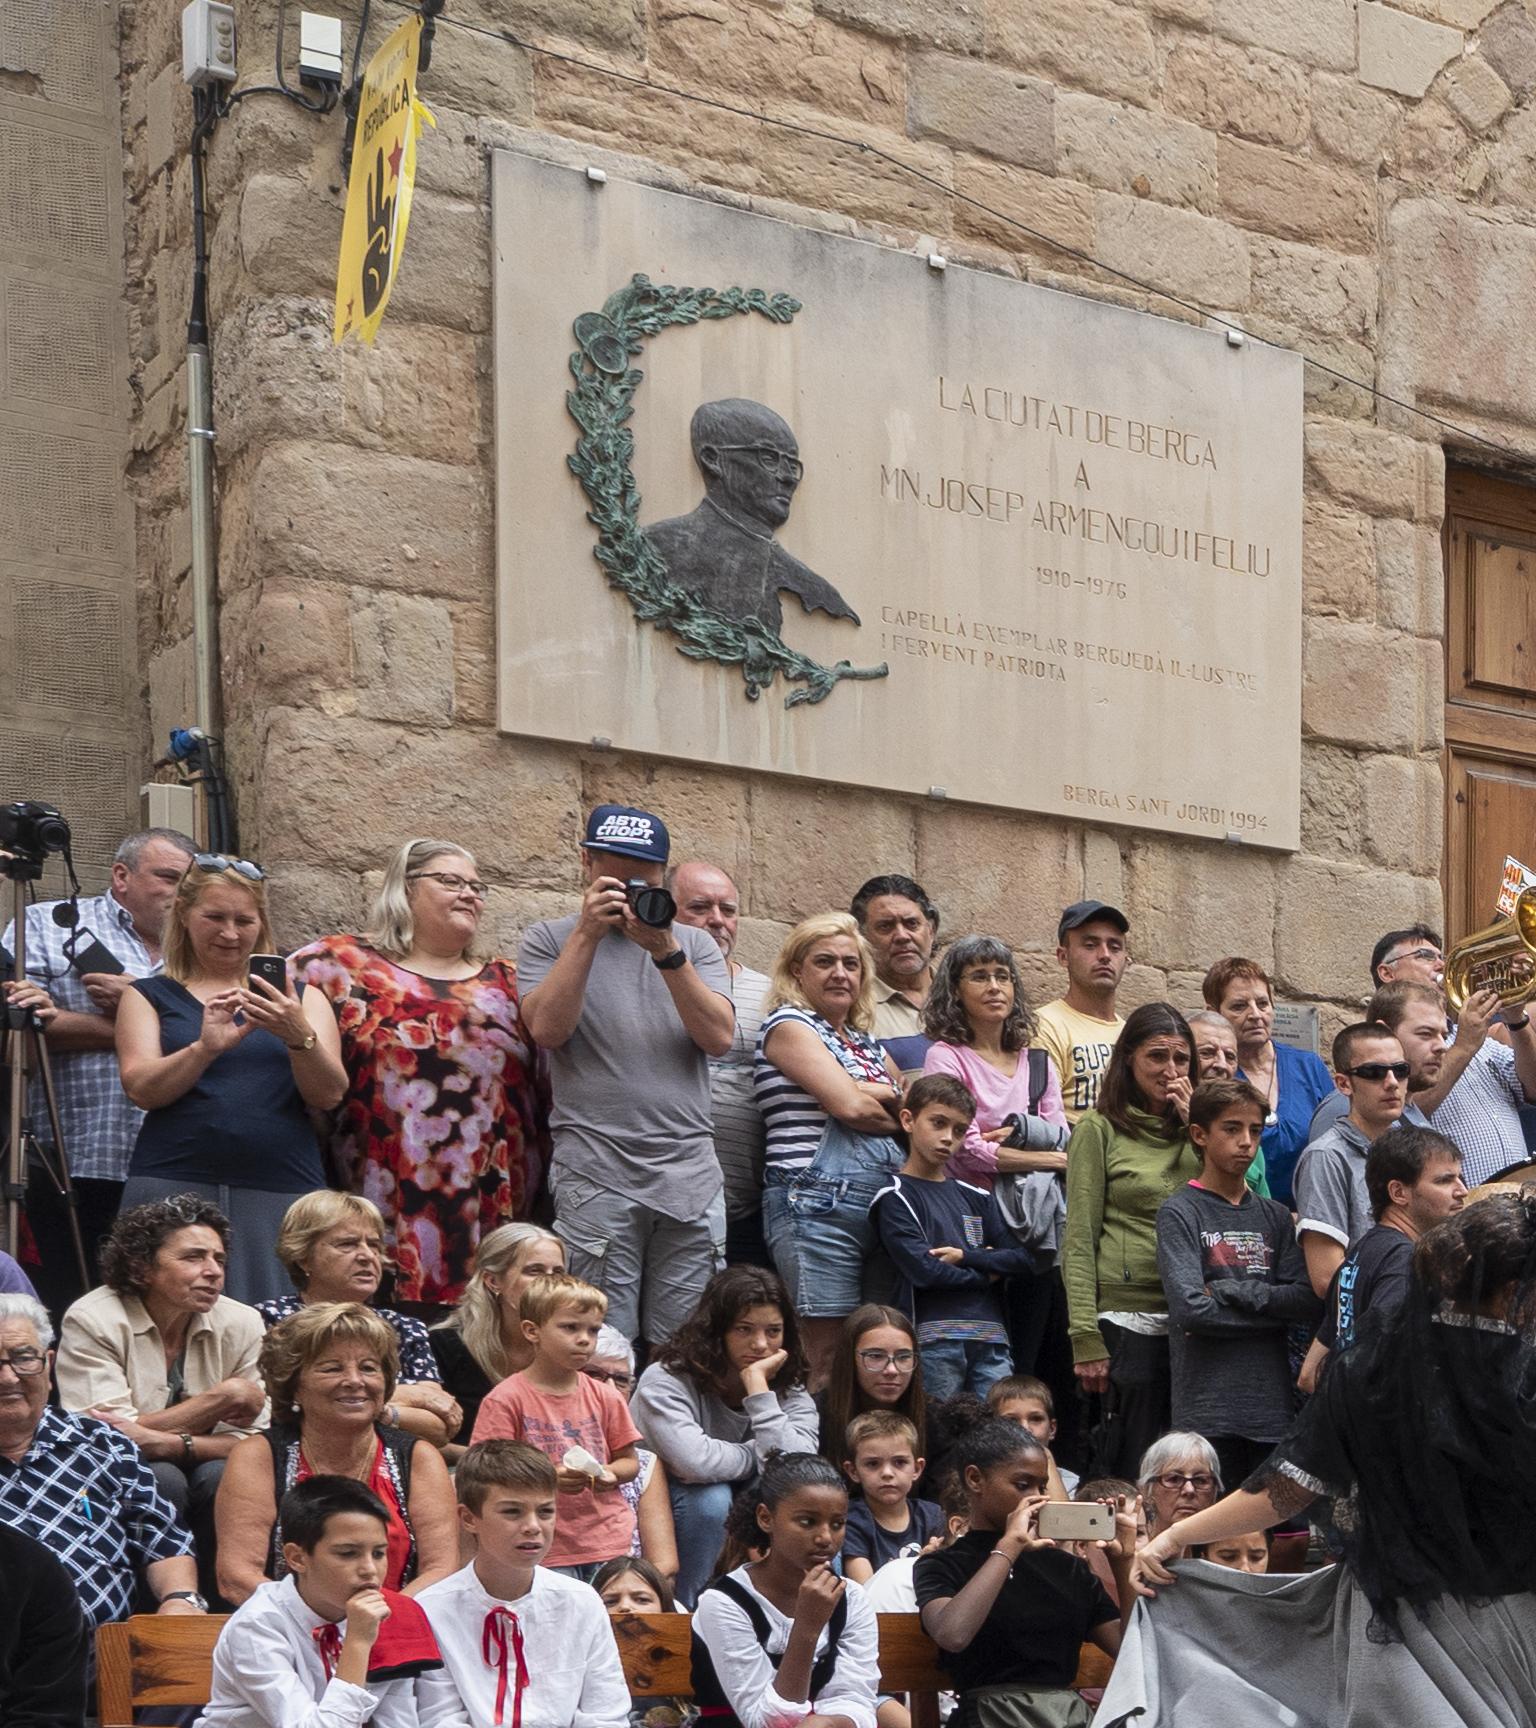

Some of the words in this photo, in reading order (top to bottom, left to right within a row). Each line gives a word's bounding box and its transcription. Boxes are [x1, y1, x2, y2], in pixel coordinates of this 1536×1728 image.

[938, 376, 977, 415] LA
[984, 387, 1081, 438] CIUTAT
[1086, 409, 1122, 449] DE
[1128, 419, 1218, 471] BERGA
[1073, 458, 1091, 491] A
[1031, 500, 1178, 559] ARMENGOU
[1183, 529, 1189, 562] I
[1194, 530, 1271, 578] FELIU
[892, 634, 978, 666] FERVENT
[984, 651, 1066, 682] PATRIOTA
[973, 622, 1068, 657] EXEMPLAR
[603, 814, 652, 829] АВТО
[1063, 784, 1121, 809] BERGA
[1126, 795, 1171, 816] SANT
[1176, 803, 1225, 826] JORDI
[1229, 811, 1269, 832] 1994
[595, 825, 655, 839] СПОРТ
